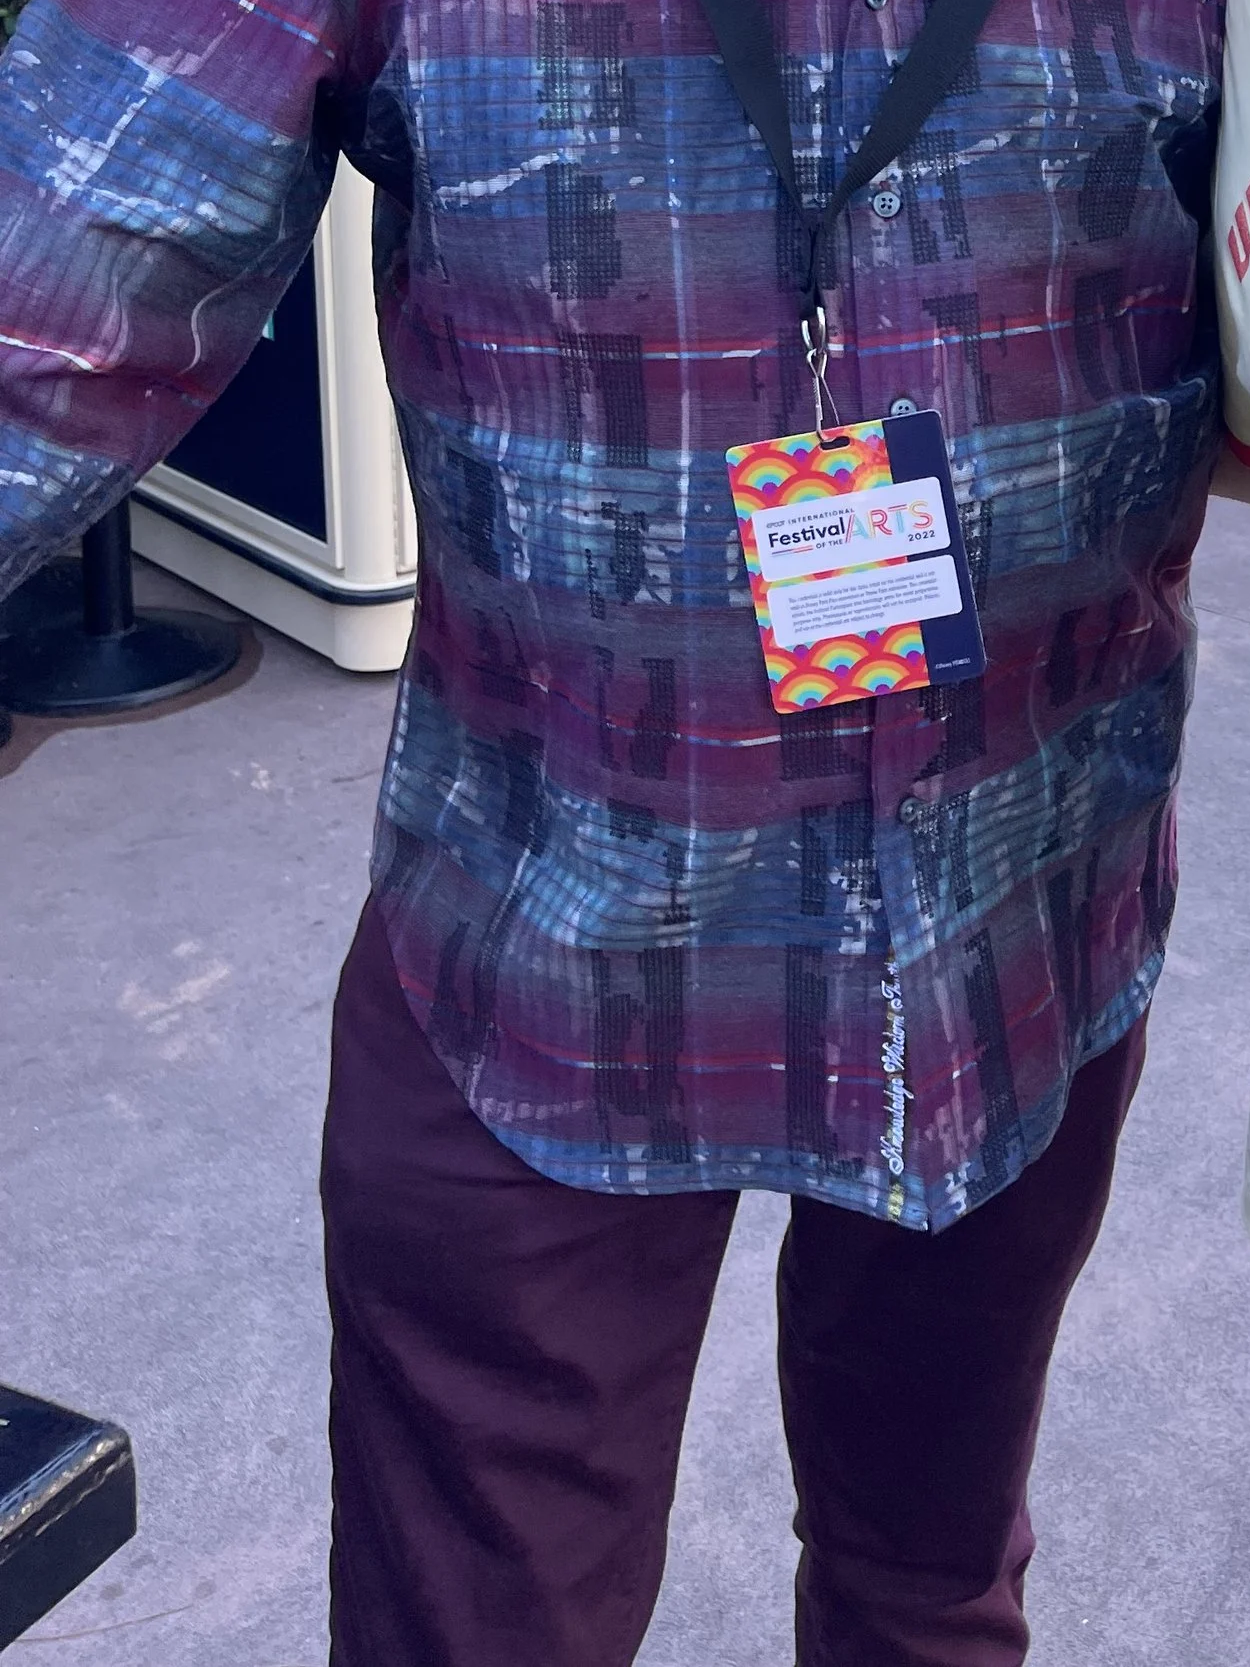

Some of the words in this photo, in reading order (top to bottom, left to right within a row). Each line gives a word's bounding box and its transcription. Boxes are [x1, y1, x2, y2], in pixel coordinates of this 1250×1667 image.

[788, 507, 855, 525] INTERNATIONAL
[768, 517, 846, 548] Festival
[845, 500, 934, 544] ARTS
[908, 530, 936, 542] 2022
[815, 541, 827, 550] OF
[828, 538, 843, 547] THE
